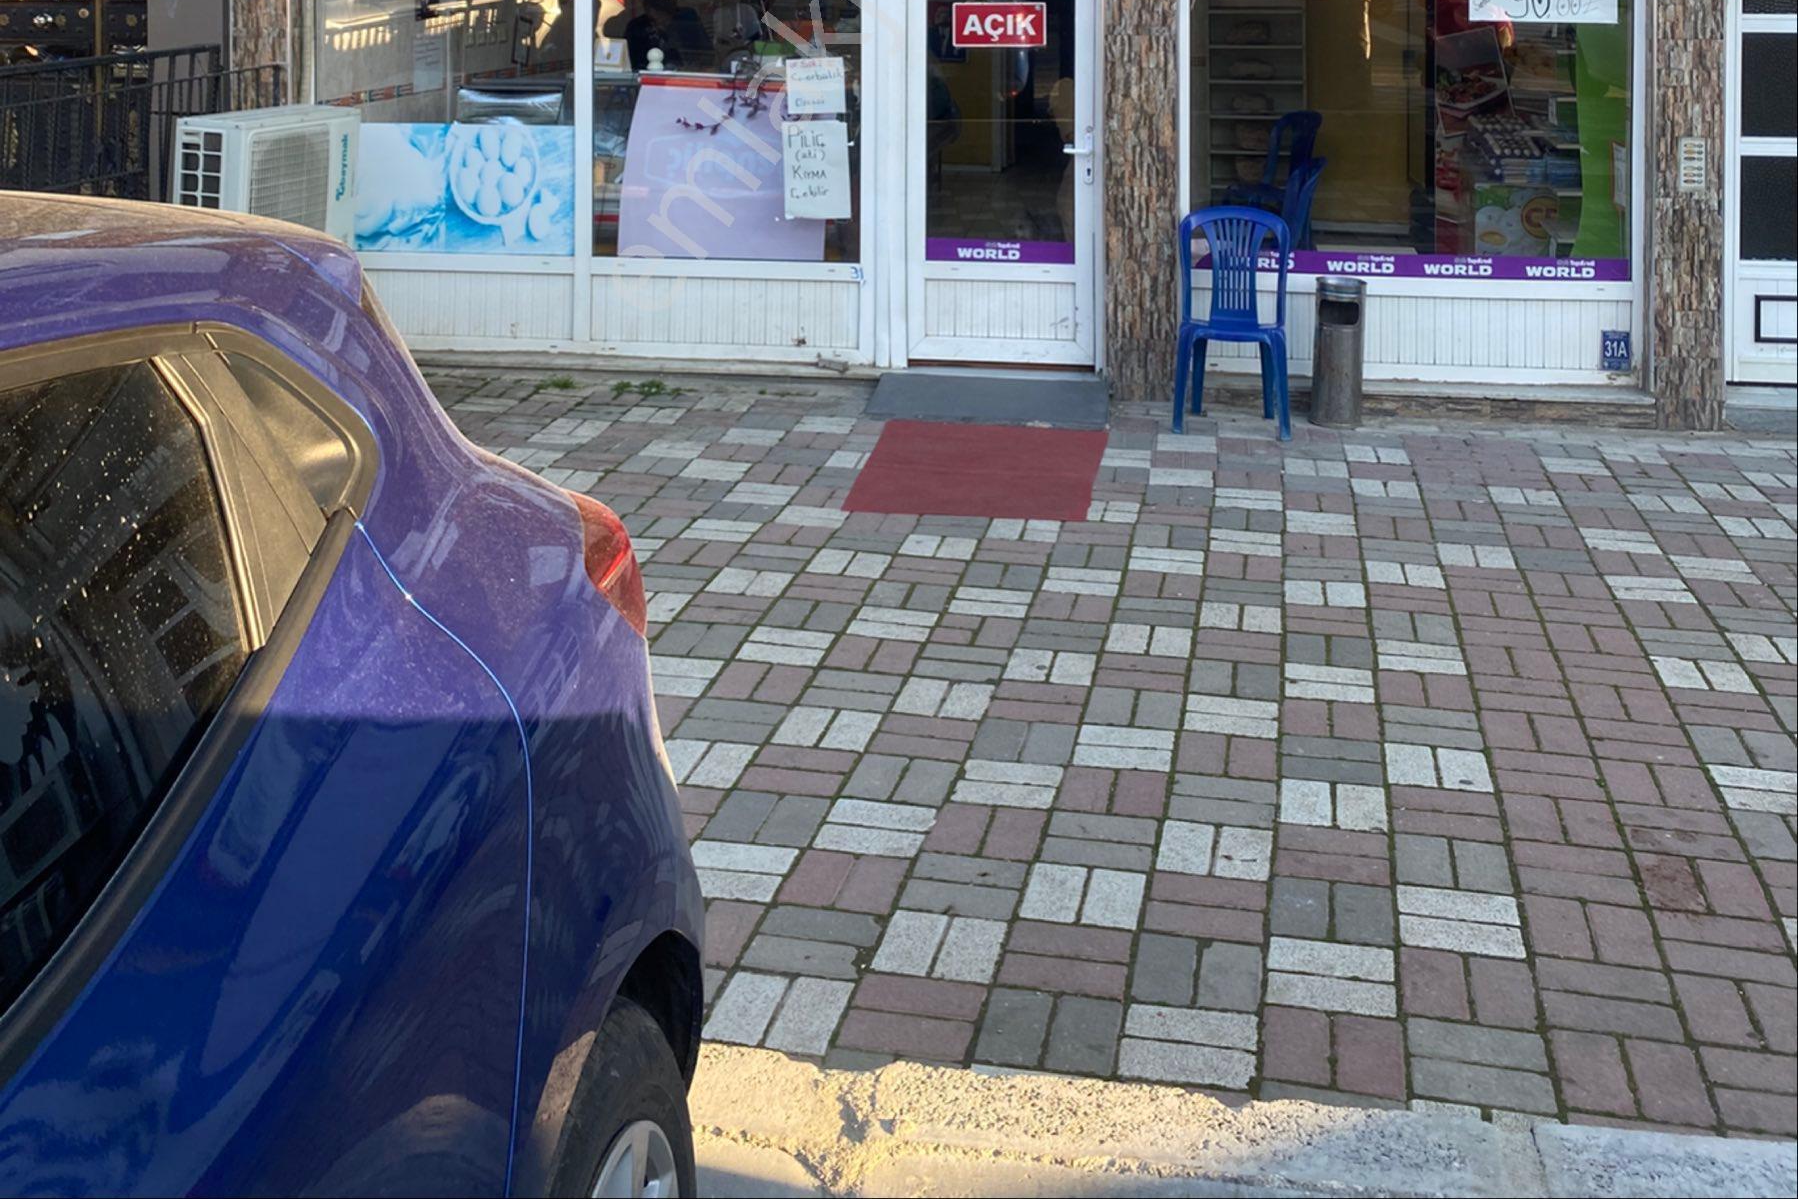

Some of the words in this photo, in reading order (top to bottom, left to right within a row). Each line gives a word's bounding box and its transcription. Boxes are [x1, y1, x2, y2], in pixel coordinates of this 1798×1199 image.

[962, 12, 1037, 42] AÇIK
[957, 247, 1021, 260] WORLD
[1326, 260, 1395, 274] WORLD
[1424, 263, 1493, 276] WORLD
[1525, 265, 1596, 278] WORLD
[1604, 340, 1628, 358] 31A
